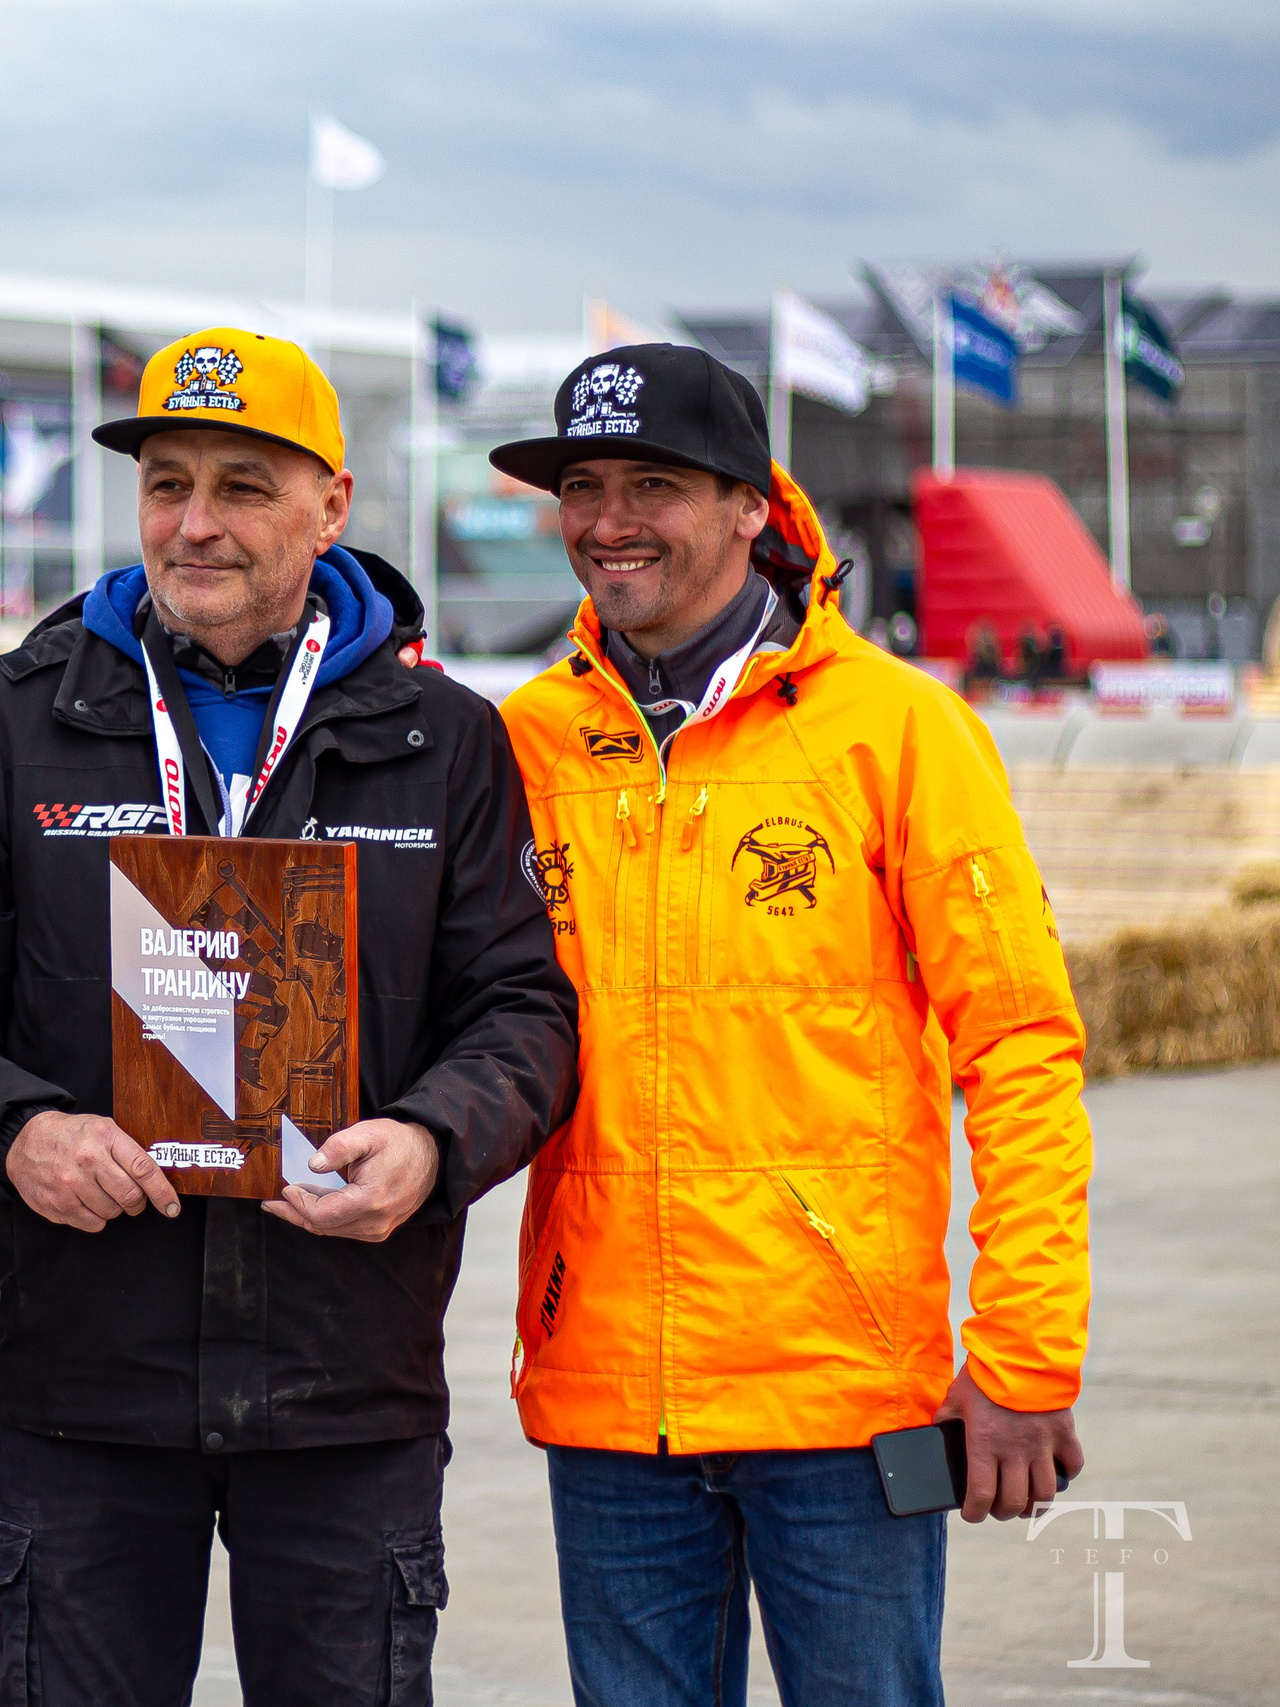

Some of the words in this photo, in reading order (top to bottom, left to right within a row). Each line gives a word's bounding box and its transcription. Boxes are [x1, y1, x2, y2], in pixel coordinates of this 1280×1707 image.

[168, 395, 206, 410] БУЙНЫЕ
[208, 395, 241, 410] ЕСТЬ?
[567, 420, 602, 437] БУЙНЫЕ
[605, 419, 640, 434] ЕСТЬ?
[765, 816, 804, 829] ELBRUS
[43, 829, 87, 837] RUSSIAN
[325, 825, 434, 841] YAKHNICH
[394, 842, 438, 850] MOTORSPORT
[767, 905, 795, 917] 5642
[140, 928, 239, 959] ВАЛЕРИЮ
[140, 968, 250, 1000] ТРАНДИНУ
[142, 1003, 150, 1012] За
[151, 1005, 200, 1015] добросовестную
[201, 1008, 230, 1016] строгость
[186, 1026, 217, 1034] гонщиков
[155, 1145, 200, 1163] БУЙНЫЕ
[204, 1149, 237, 1165] ЕСТЬ?
